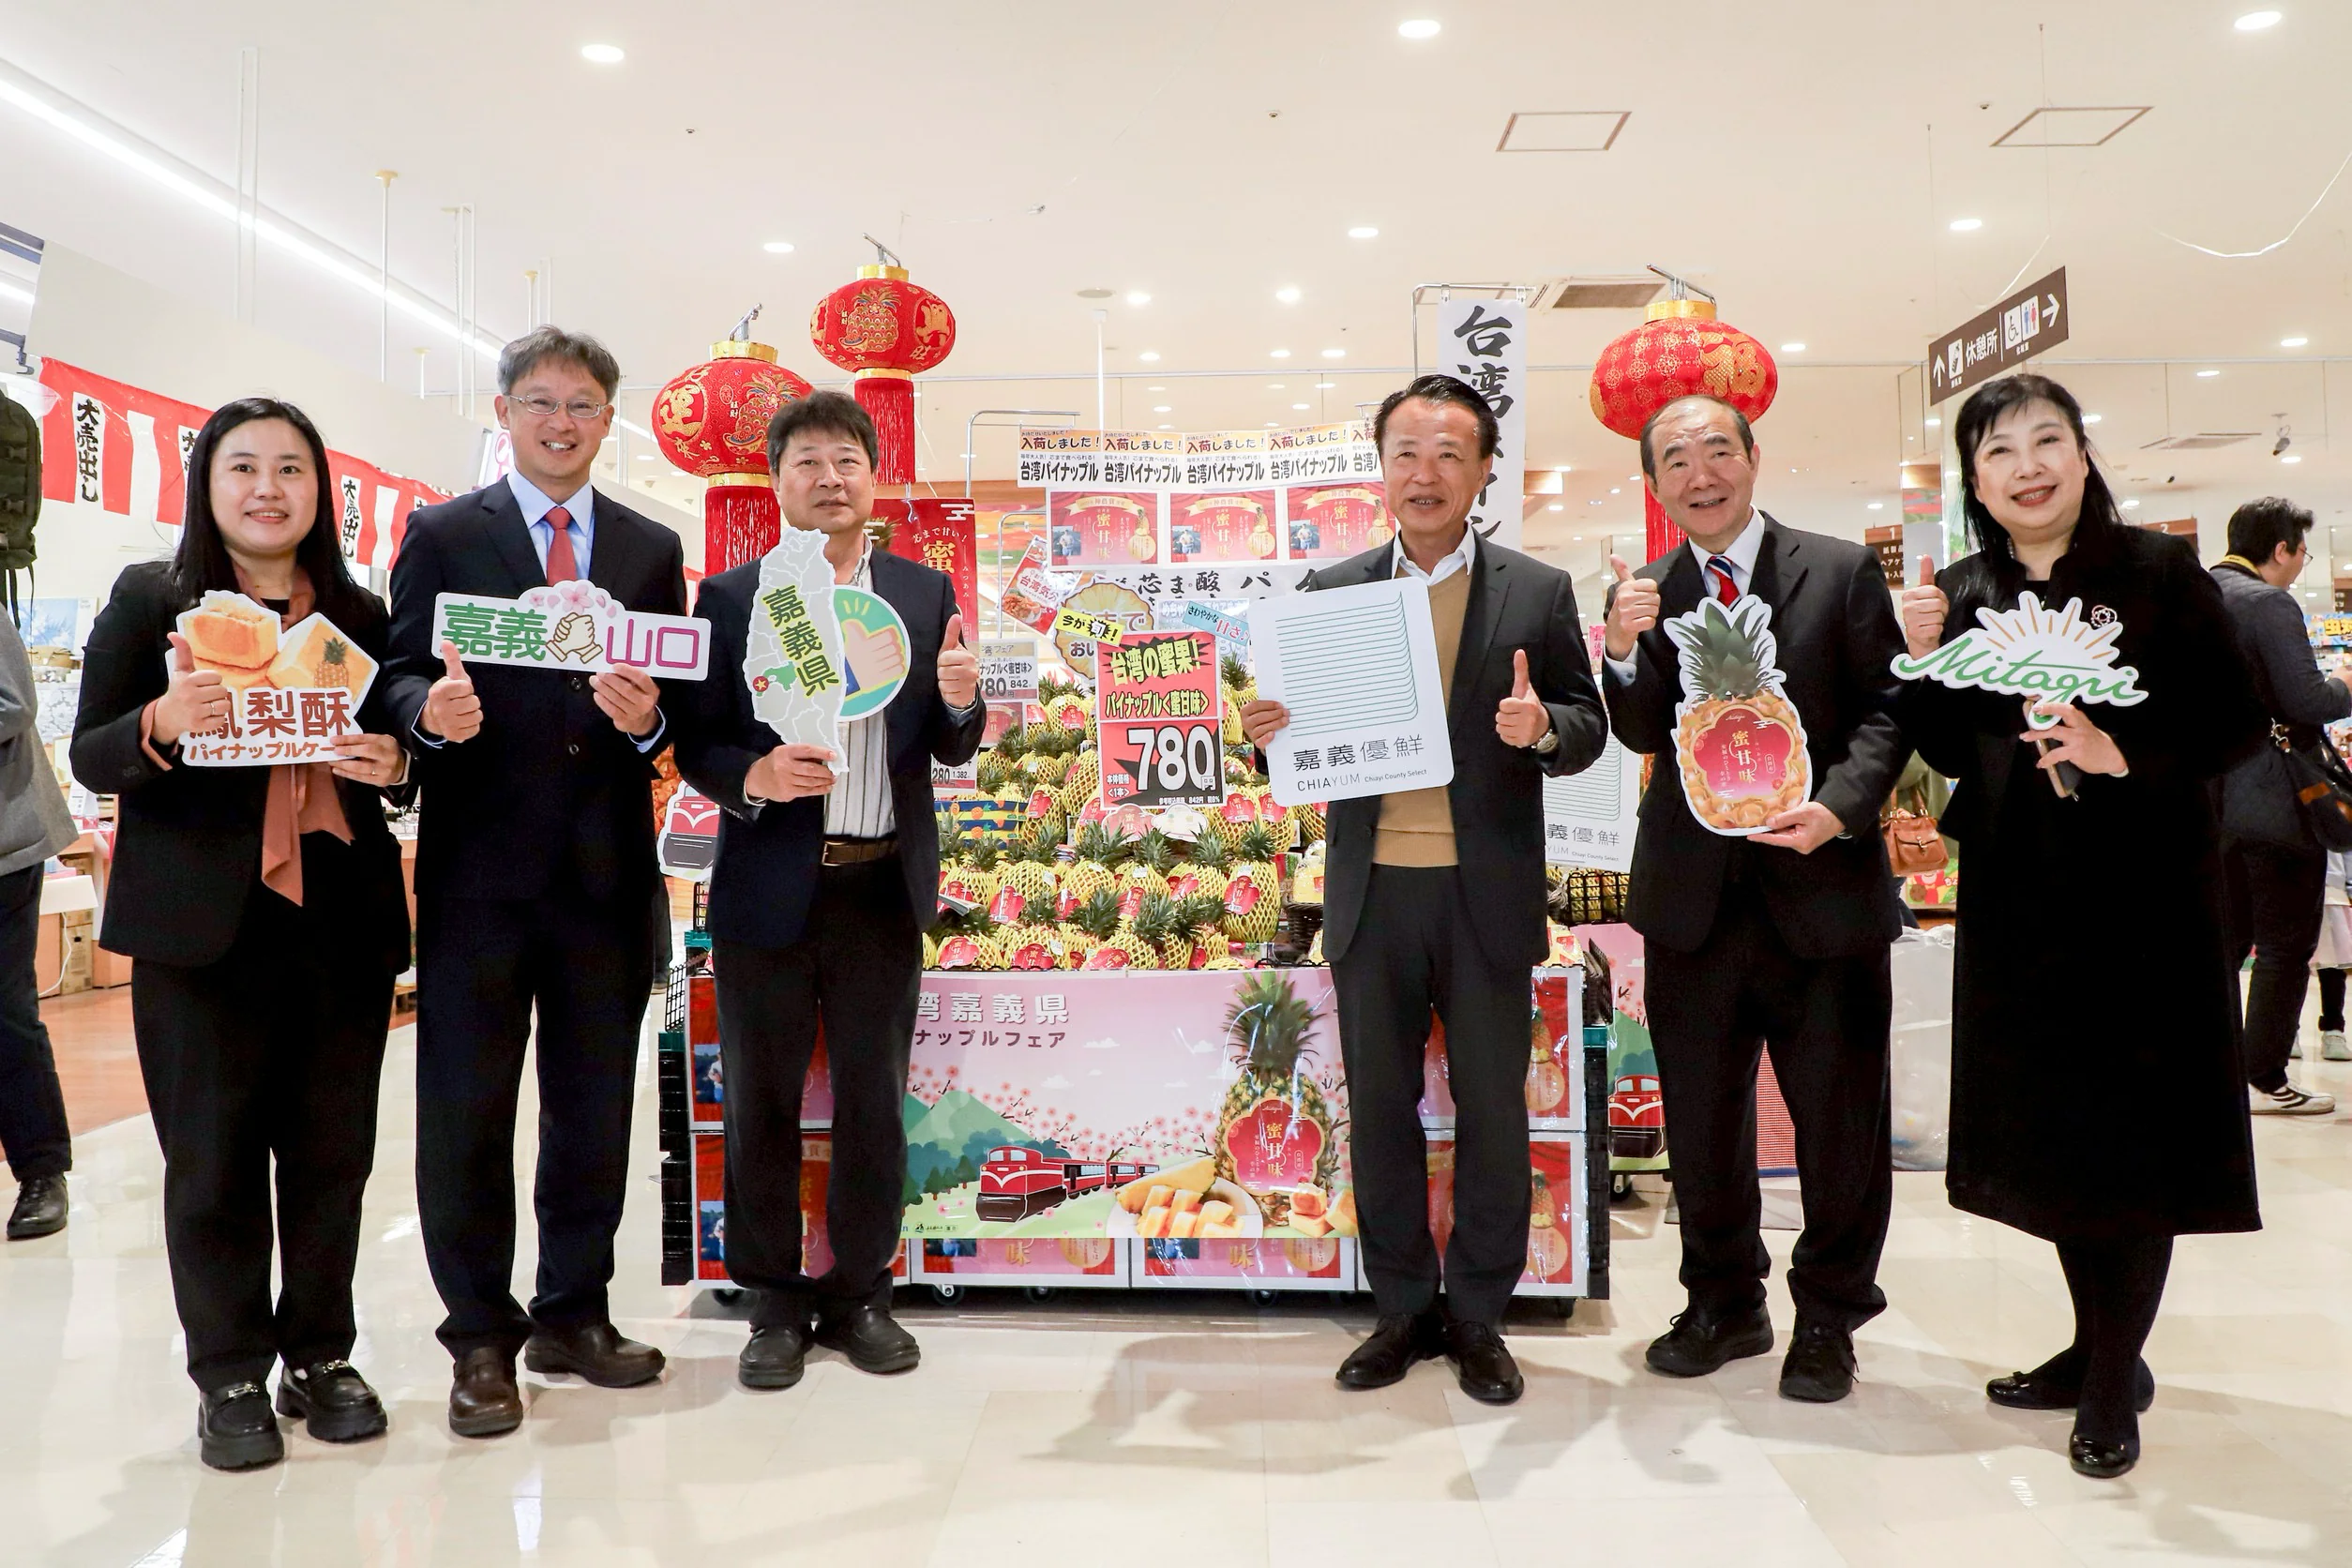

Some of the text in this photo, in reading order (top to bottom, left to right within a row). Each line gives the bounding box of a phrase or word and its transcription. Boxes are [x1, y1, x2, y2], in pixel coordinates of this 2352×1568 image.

[1966, 327, 1998, 368] 休憩所
[77, 398, 100, 503] 大売出し
[1021, 437, 1100, 450] 入荷しました！
[1105, 438, 1182, 451] 入荷しました！
[1186, 438, 1265, 454] 入荷しました！
[1270, 429, 1348, 451] 入荷しました！
[1020, 460, 1099, 481] 台湾パイナップル
[1105, 462, 1182, 483] 台湾パイナップル
[1187, 461, 1265, 484] 台湾パイナップル
[1270, 455, 1348, 479] 台湾パイナップル
[342, 479, 360, 558] 大売出し
[2160, 522, 2169, 535] 2
[1096, 513, 1111, 561] 蜜甘味
[1215, 513, 1230, 559] 蜜甘味
[1889, 527, 1895, 540] 1
[441, 602, 701, 670] 嘉義 山口
[761, 584, 839, 697] 嘉義県
[1110, 639, 1201, 686] 台湾の蜜果！
[1898, 637, 2142, 723] Mitagri
[1292, 733, 1425, 772] 嘉義優鮮
[1731, 731, 1756, 785] 蜜甘味
[1297, 769, 1427, 792] CHIAYUM Chiayi County Select
[1546, 823, 1621, 847] 義優鮮
[914, 1029, 1066, 1048] ナップルフェア
[1266, 1123, 1284, 1179] 蜜甘味
